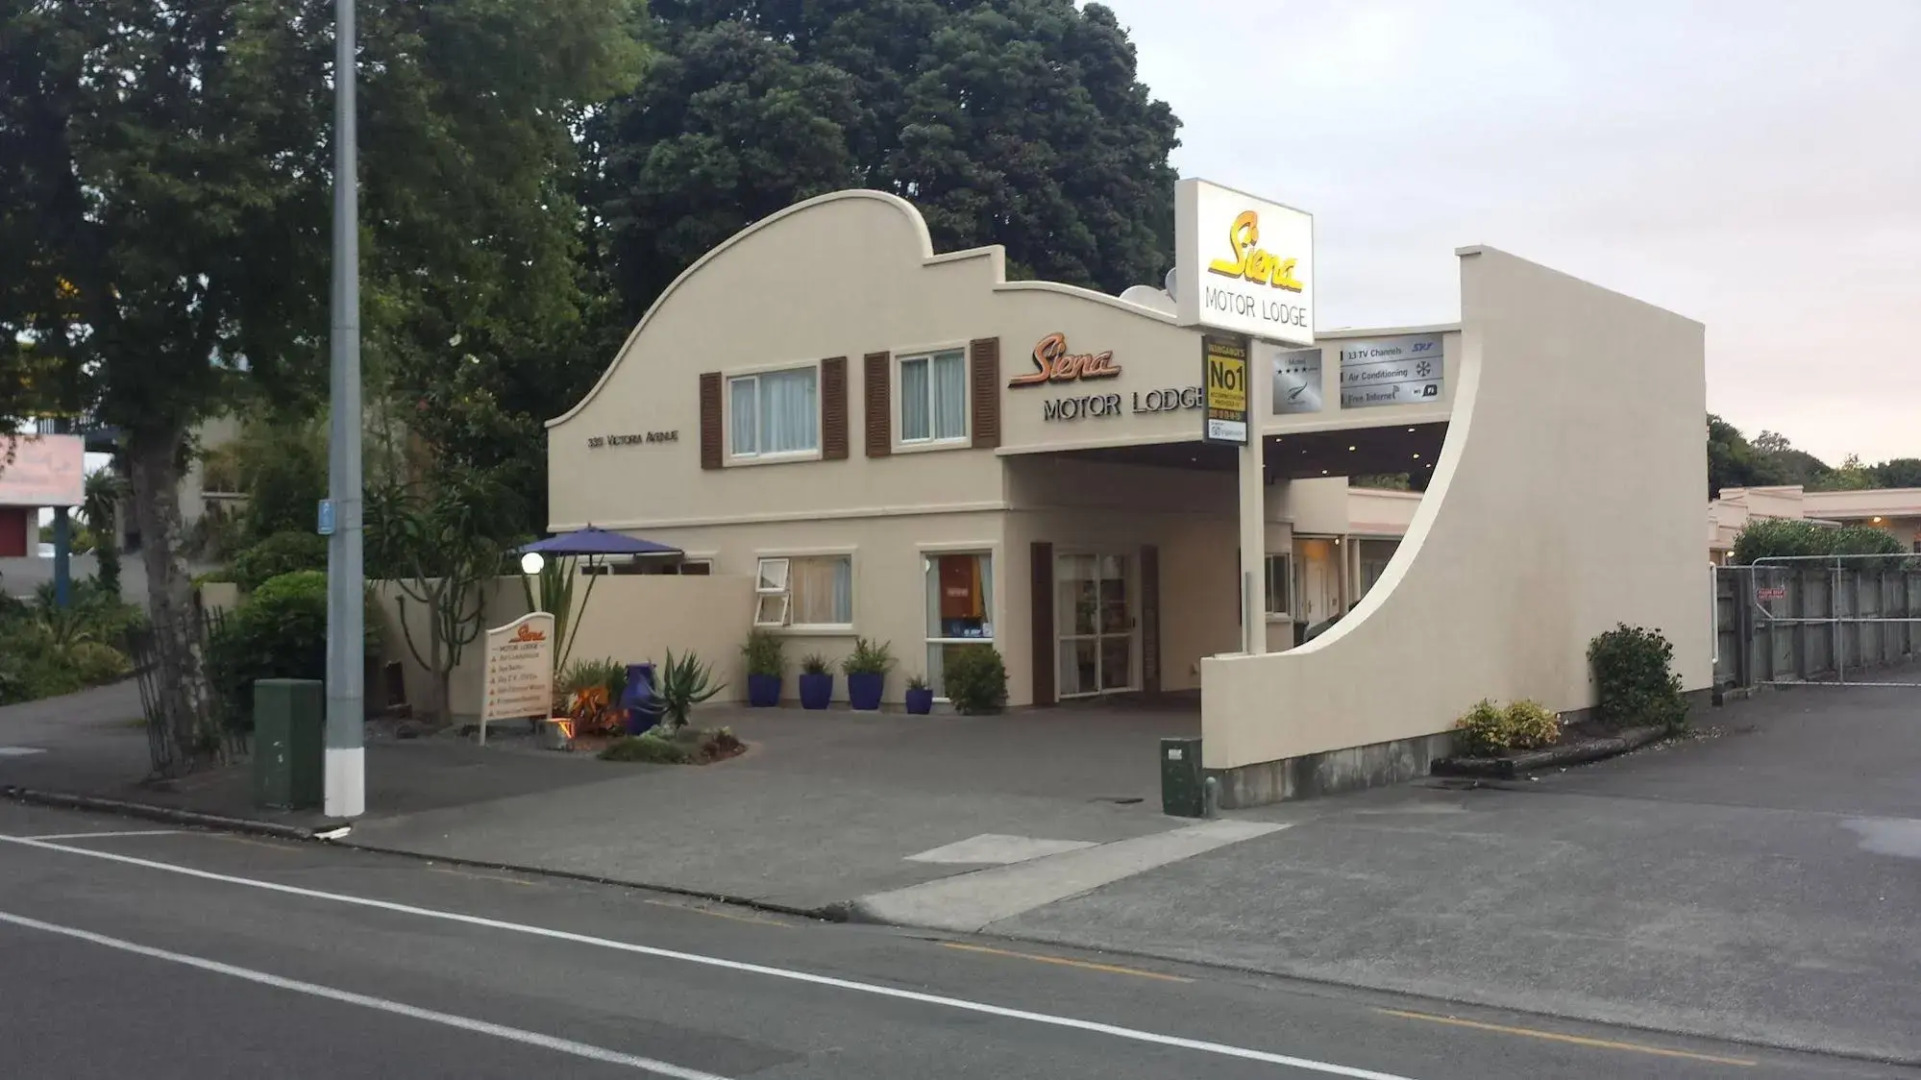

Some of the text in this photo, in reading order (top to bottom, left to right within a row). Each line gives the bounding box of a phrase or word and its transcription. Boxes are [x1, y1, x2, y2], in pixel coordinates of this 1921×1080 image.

[1208, 210, 1303, 293] Siena
[1205, 286, 1308, 327] MOTOR LODGE
[1008, 332, 1122, 388] Siena
[1358, 350, 1368, 359] TV
[1370, 347, 1402, 357] Channels
[1348, 369, 1408, 382] Air Conditioning
[1043, 393, 1122, 421] MOTOR
[1366, 390, 1396, 402] Internet
